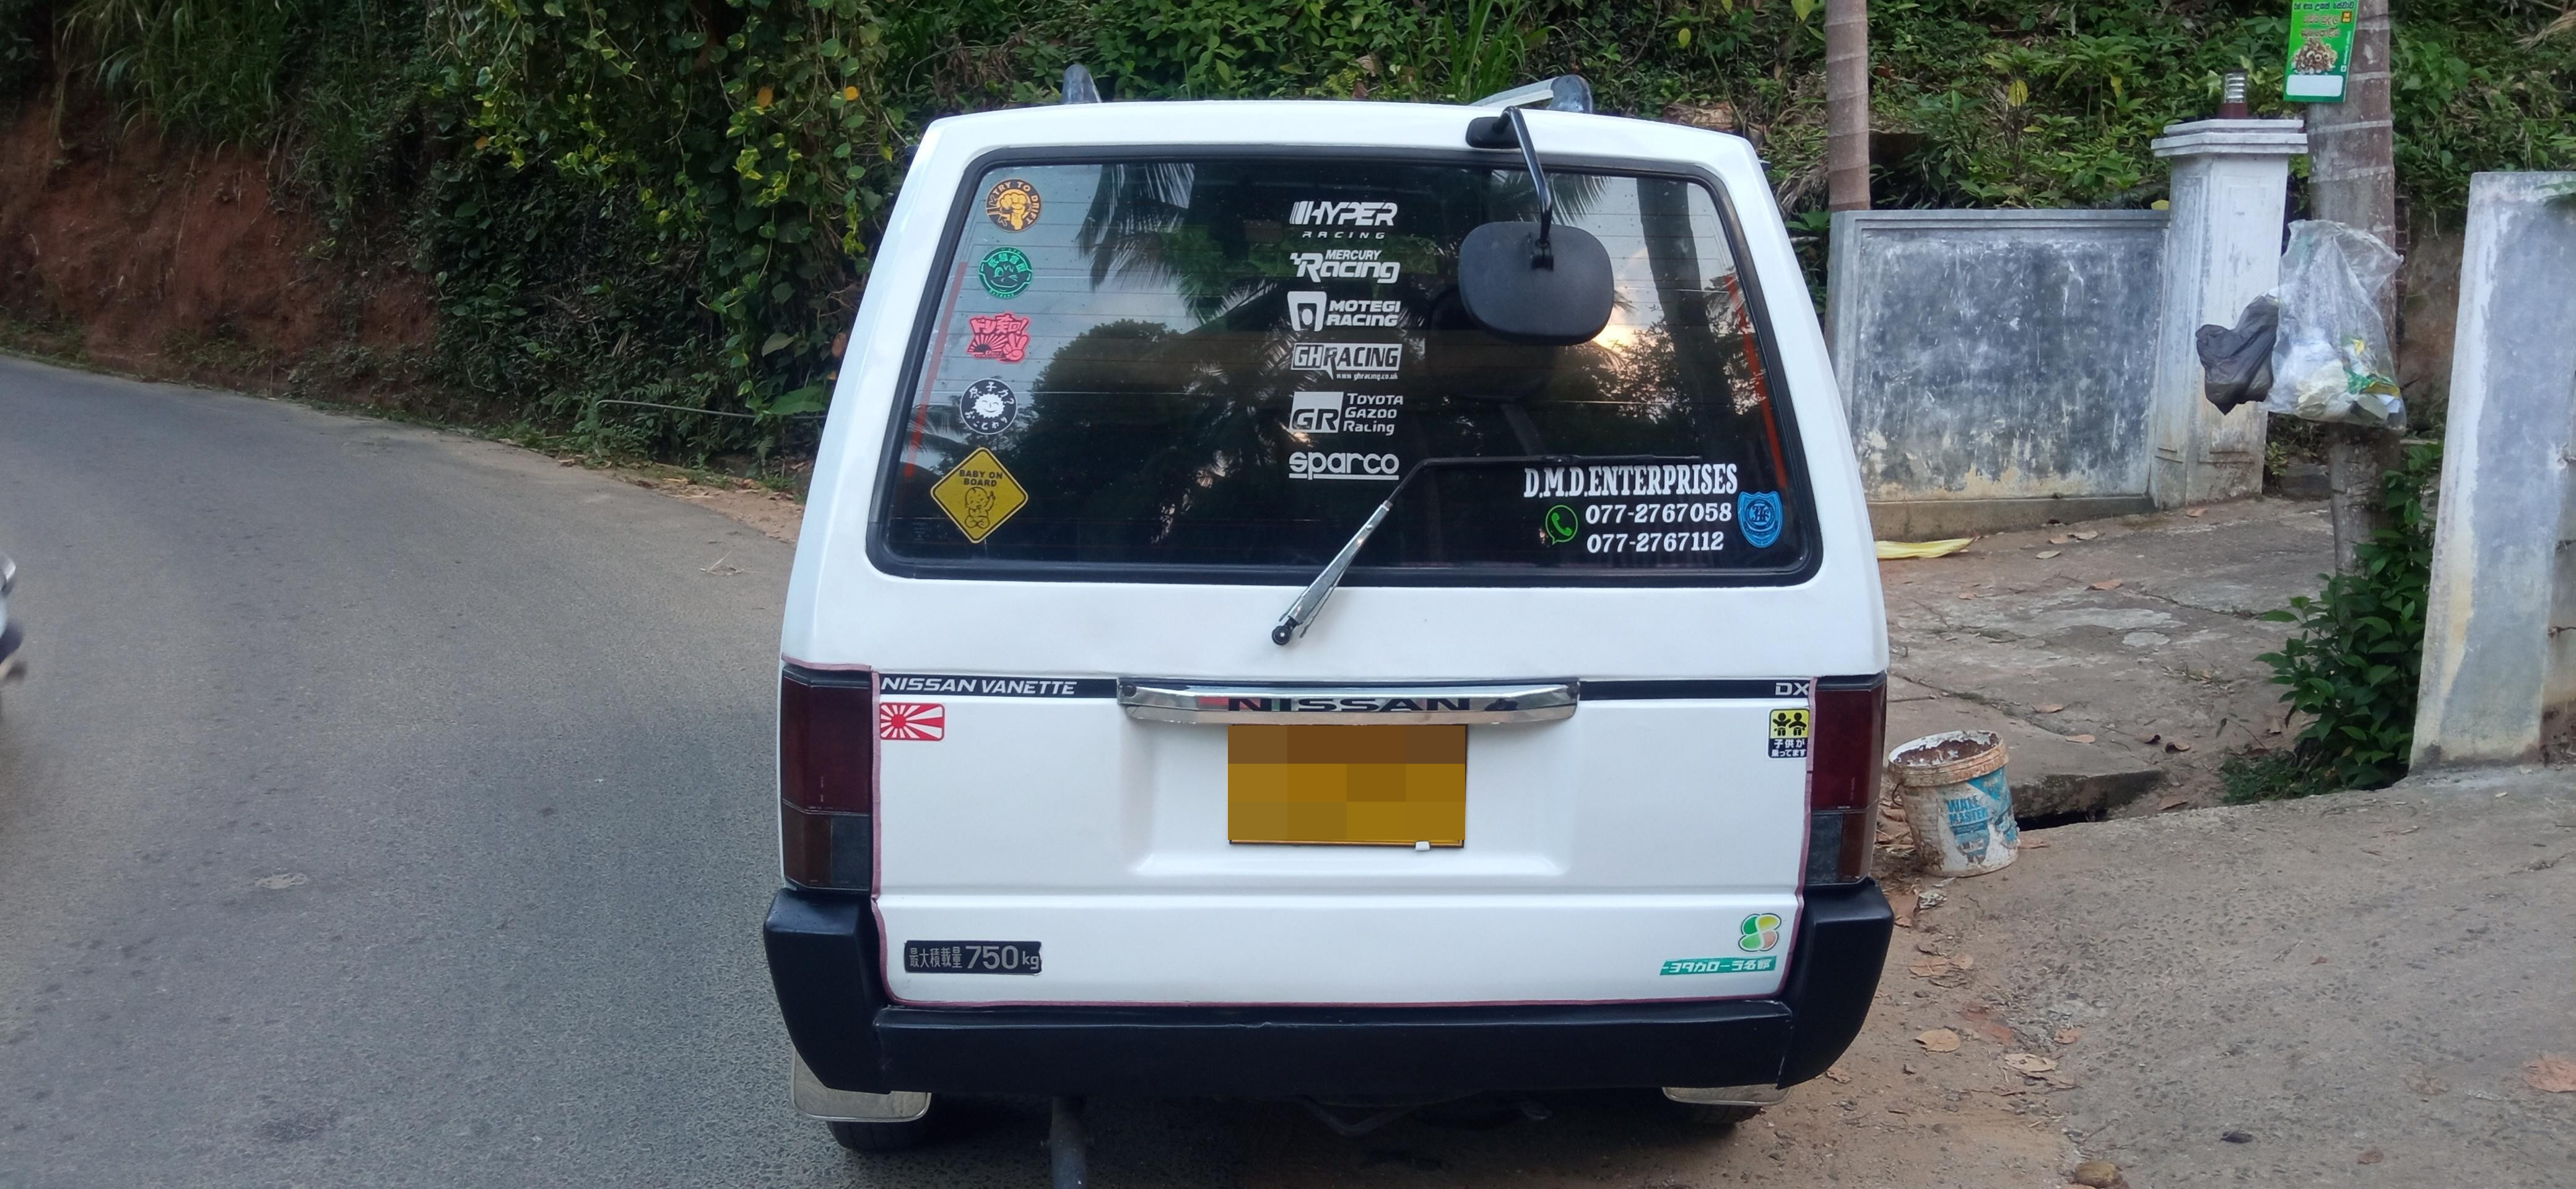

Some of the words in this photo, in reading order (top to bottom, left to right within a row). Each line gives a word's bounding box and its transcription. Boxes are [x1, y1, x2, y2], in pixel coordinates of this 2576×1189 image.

[993, 181, 1011, 195] TRY
[1017, 181, 1031, 192] TO
[1025, 194, 1040, 224] DRIFT
[1290, 201, 1398, 226] HYPER
[1302, 231, 1386, 240] RACING
[1325, 249, 1382, 261] MERCURY
[1290, 252, 1401, 284] Racing
[1328, 300, 1401, 313] MOTEGI
[1326, 314, 1399, 327] RACING
[1347, 393, 1404, 405] TOYOTA
[1291, 408, 1339, 430] GR
[1343, 420, 1395, 436] Racing
[1289, 451, 1400, 481] sparco
[959, 469, 985, 478] BABY
[989, 471, 1003, 479] ON
[964, 477, 997, 487] BOARD
[1585, 502, 1732, 525] 077-2767058
[1586, 531, 1725, 553] 077-2767112
[881, 677, 978, 692] NISSAN
[981, 679, 1078, 695] VANETTE
[1775, 682, 1809, 695] DX
[1228, 697, 1471, 712] NISSAN
[1773, 739, 1805, 749] 子供が
[965, 945, 1019, 969] 750
